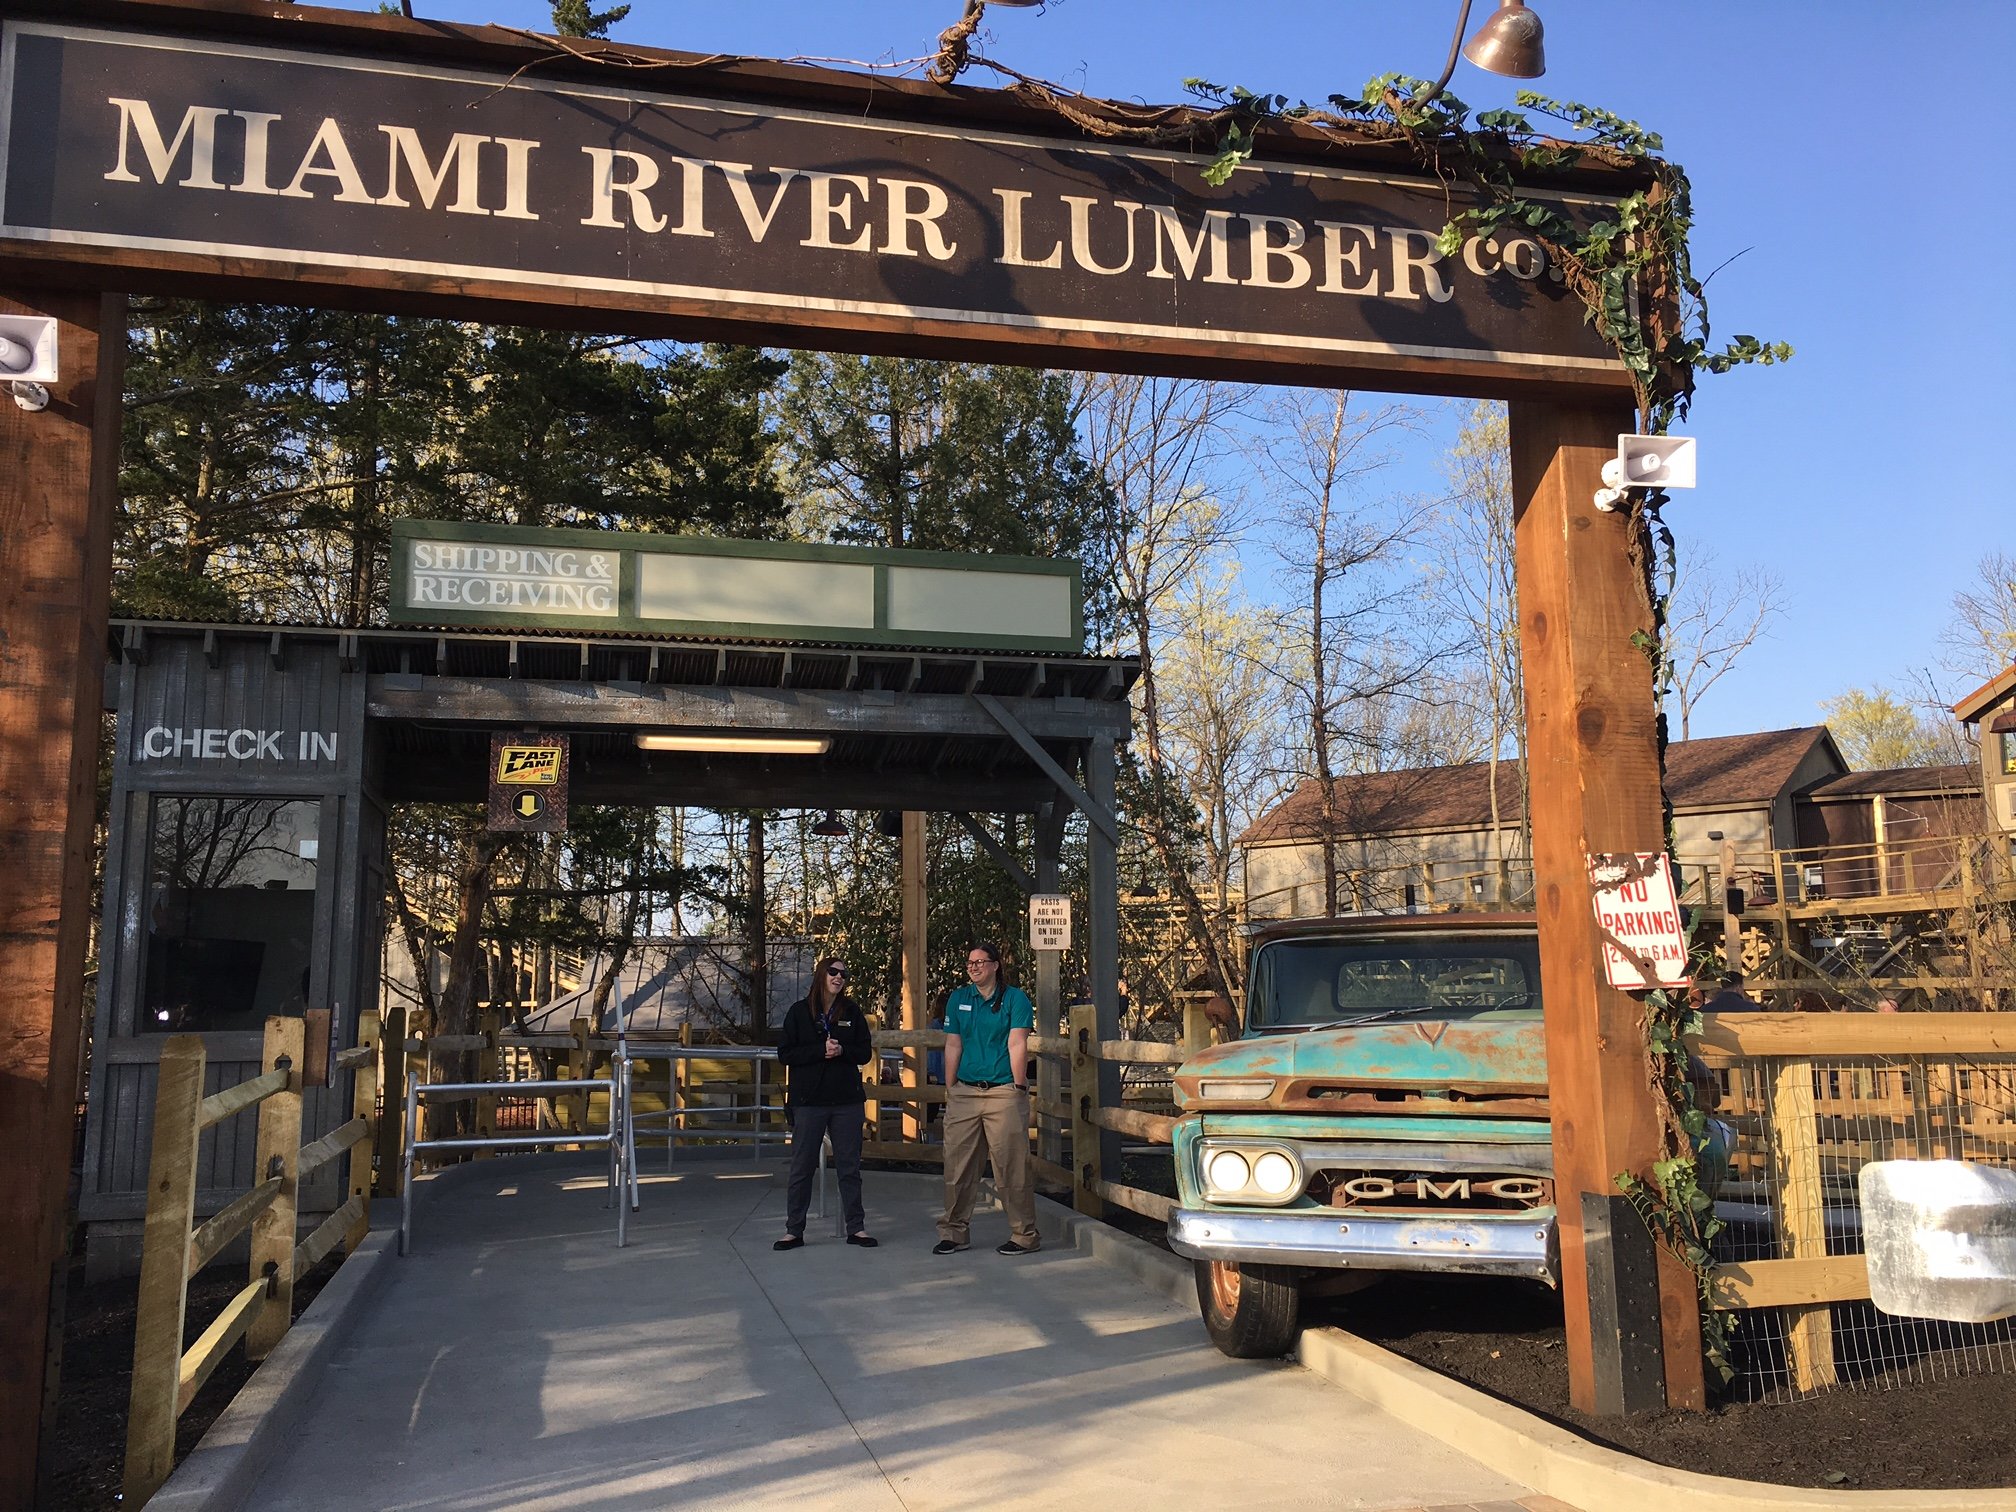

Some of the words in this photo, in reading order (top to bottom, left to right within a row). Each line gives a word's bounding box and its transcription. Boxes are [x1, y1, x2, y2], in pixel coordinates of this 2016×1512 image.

[104, 97, 539, 221] MIAMI
[581, 146, 957, 261] RIVER
[992, 188, 1455, 304] LUMBER
[413, 544, 579, 578] SHIPPING
[585, 554, 612, 579] &
[413, 576, 612, 611] RECEIVING
[143, 726, 284, 760] CHECK
[300, 731, 338, 761] IN
[505, 759, 554, 774] LANE
[508, 751, 556, 762] FAST
[1619, 878, 1648, 903] NO
[1603, 911, 1675, 936] PARKING
[1610, 947, 1618, 963] 2
[1652, 945, 1660, 961] 6
[1344, 1176, 1545, 1200] GMC
